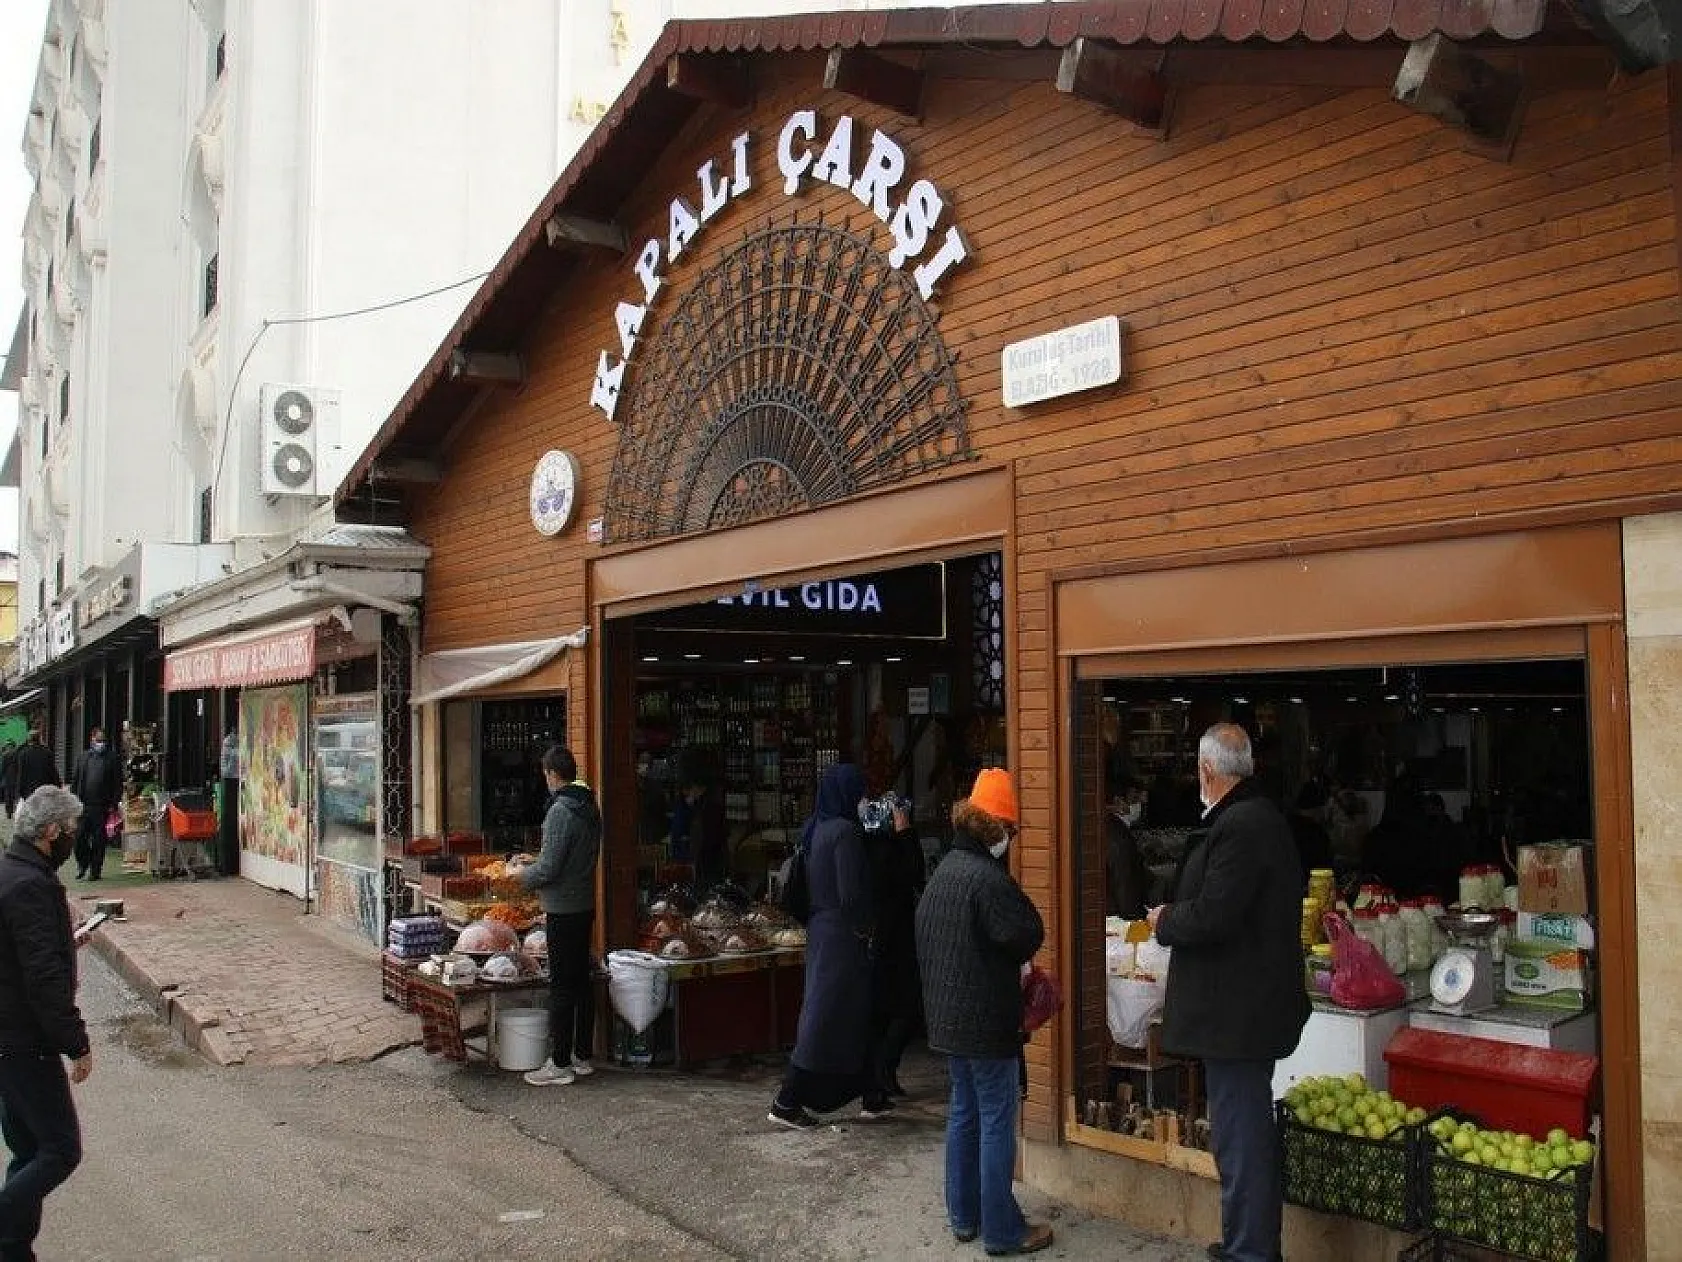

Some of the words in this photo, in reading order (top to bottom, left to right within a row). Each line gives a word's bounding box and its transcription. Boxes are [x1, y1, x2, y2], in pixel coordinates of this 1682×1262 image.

[589, 132, 753, 421] KAPALI
[777, 110, 968, 301] ÇARŞI
[801, 582, 882, 612] GIDA
